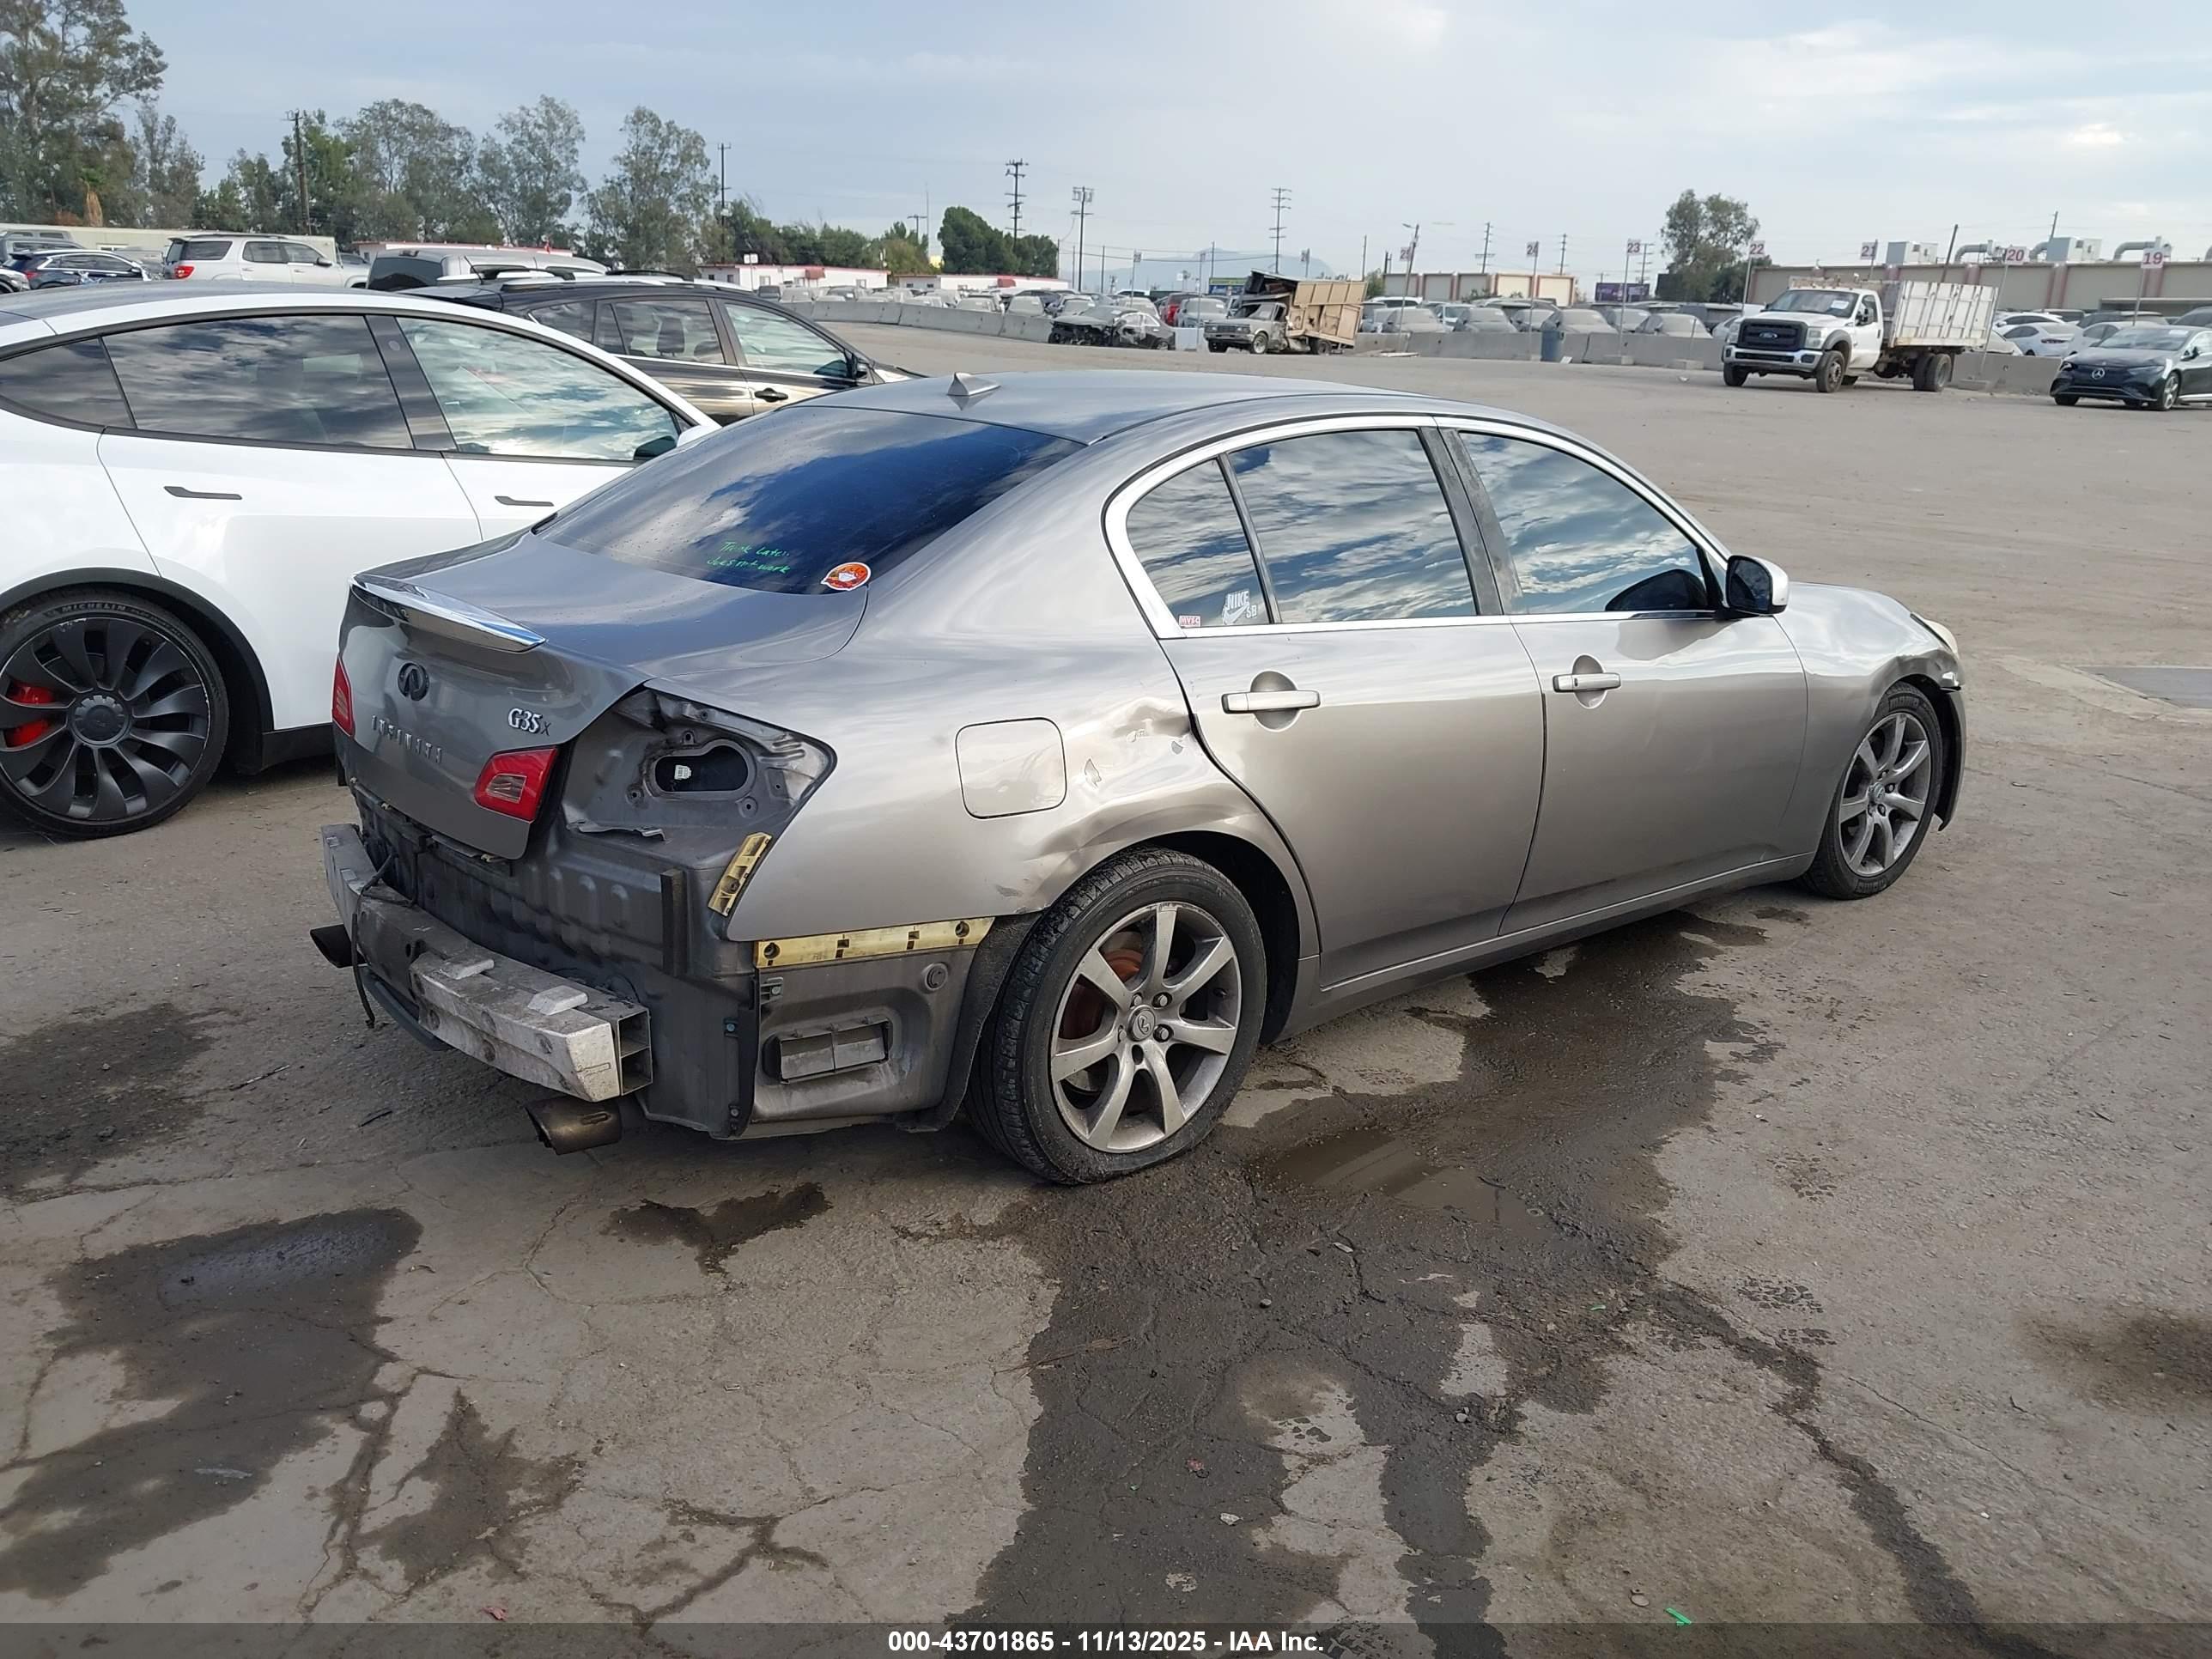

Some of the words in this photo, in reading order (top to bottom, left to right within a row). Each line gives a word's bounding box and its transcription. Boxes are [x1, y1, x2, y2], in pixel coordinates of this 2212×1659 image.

[1626, 242, 1641, 253] 23
[1749, 243, 1765, 255] 22
[2006, 248, 2025, 262] 20
[2143, 252, 2163, 265] 19
[1225, 590, 1250, 611] NIKE
[61, 602, 126, 613] MICHELIN
[1245, 604, 1258, 619] SB
